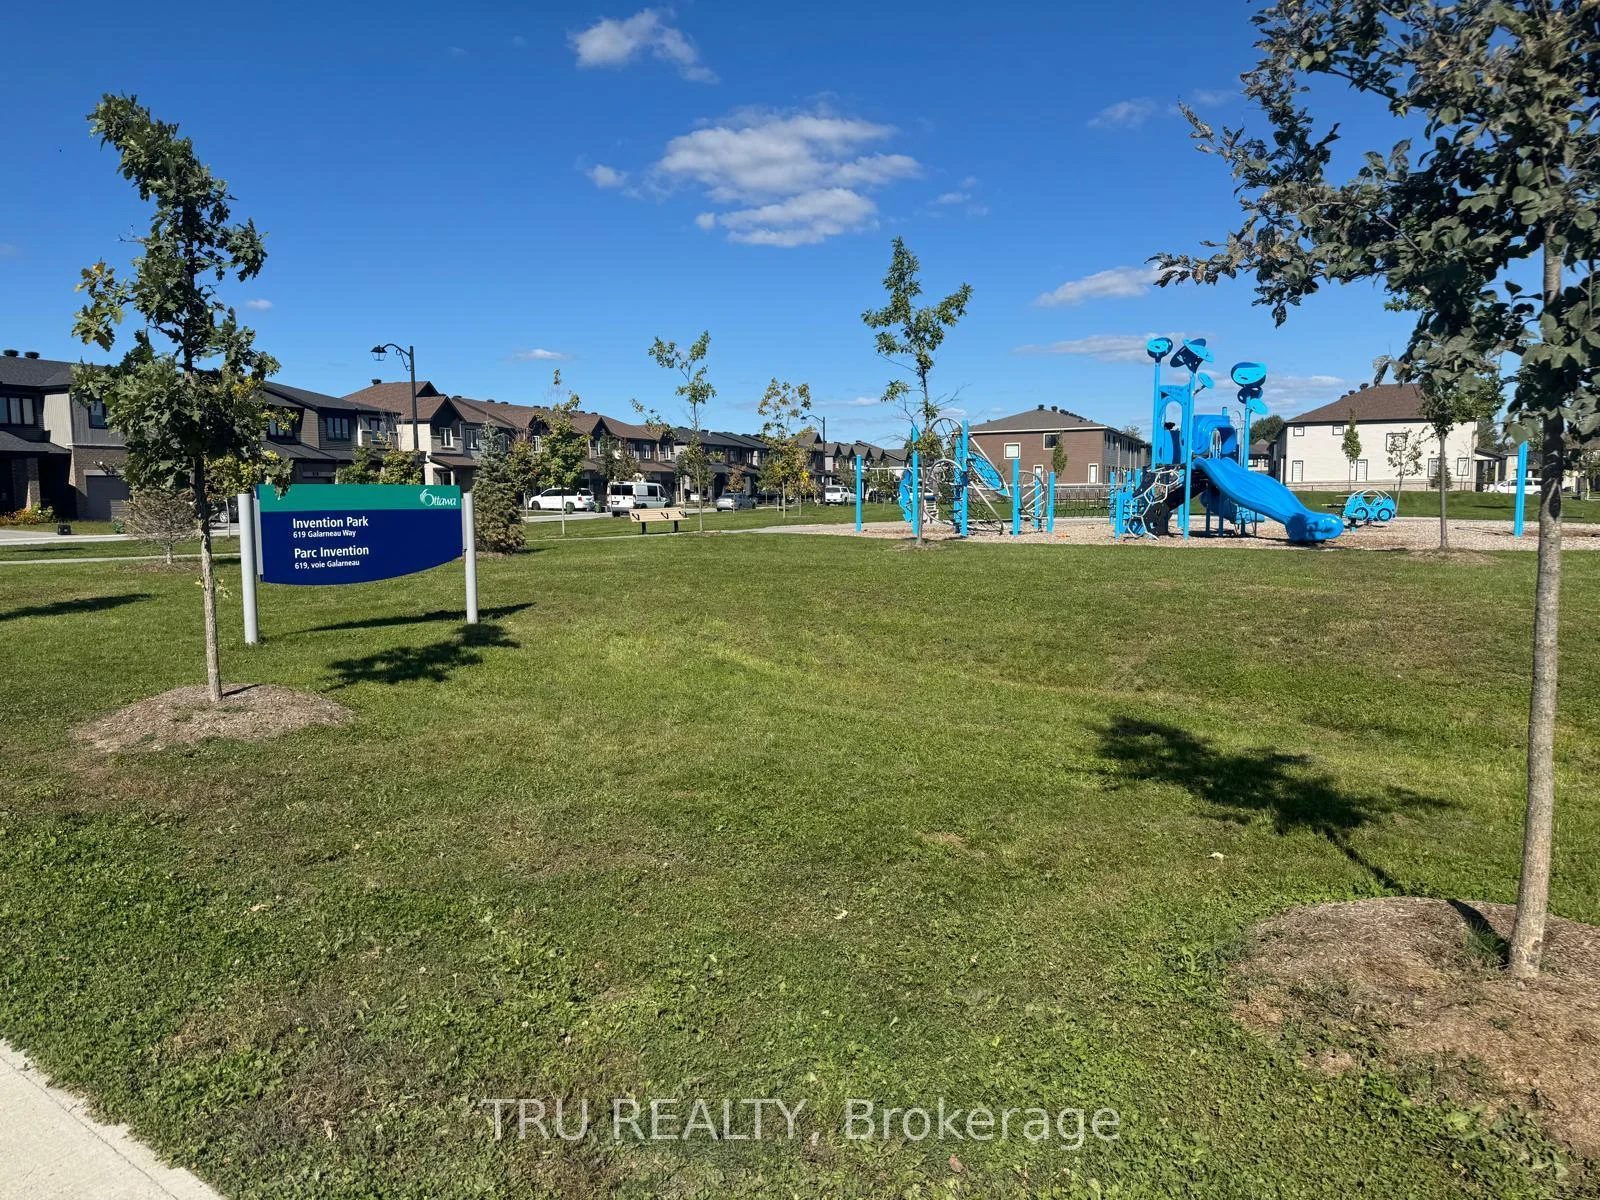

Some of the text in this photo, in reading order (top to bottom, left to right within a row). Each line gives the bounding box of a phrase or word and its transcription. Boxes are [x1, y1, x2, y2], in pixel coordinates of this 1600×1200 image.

[420, 489, 456, 506] Ottawa
[293, 516, 368, 528] Invention Park
[308, 530, 341, 538] Galarneau
[342, 529, 356, 537] Way
[294, 545, 369, 558] Parc Invention
